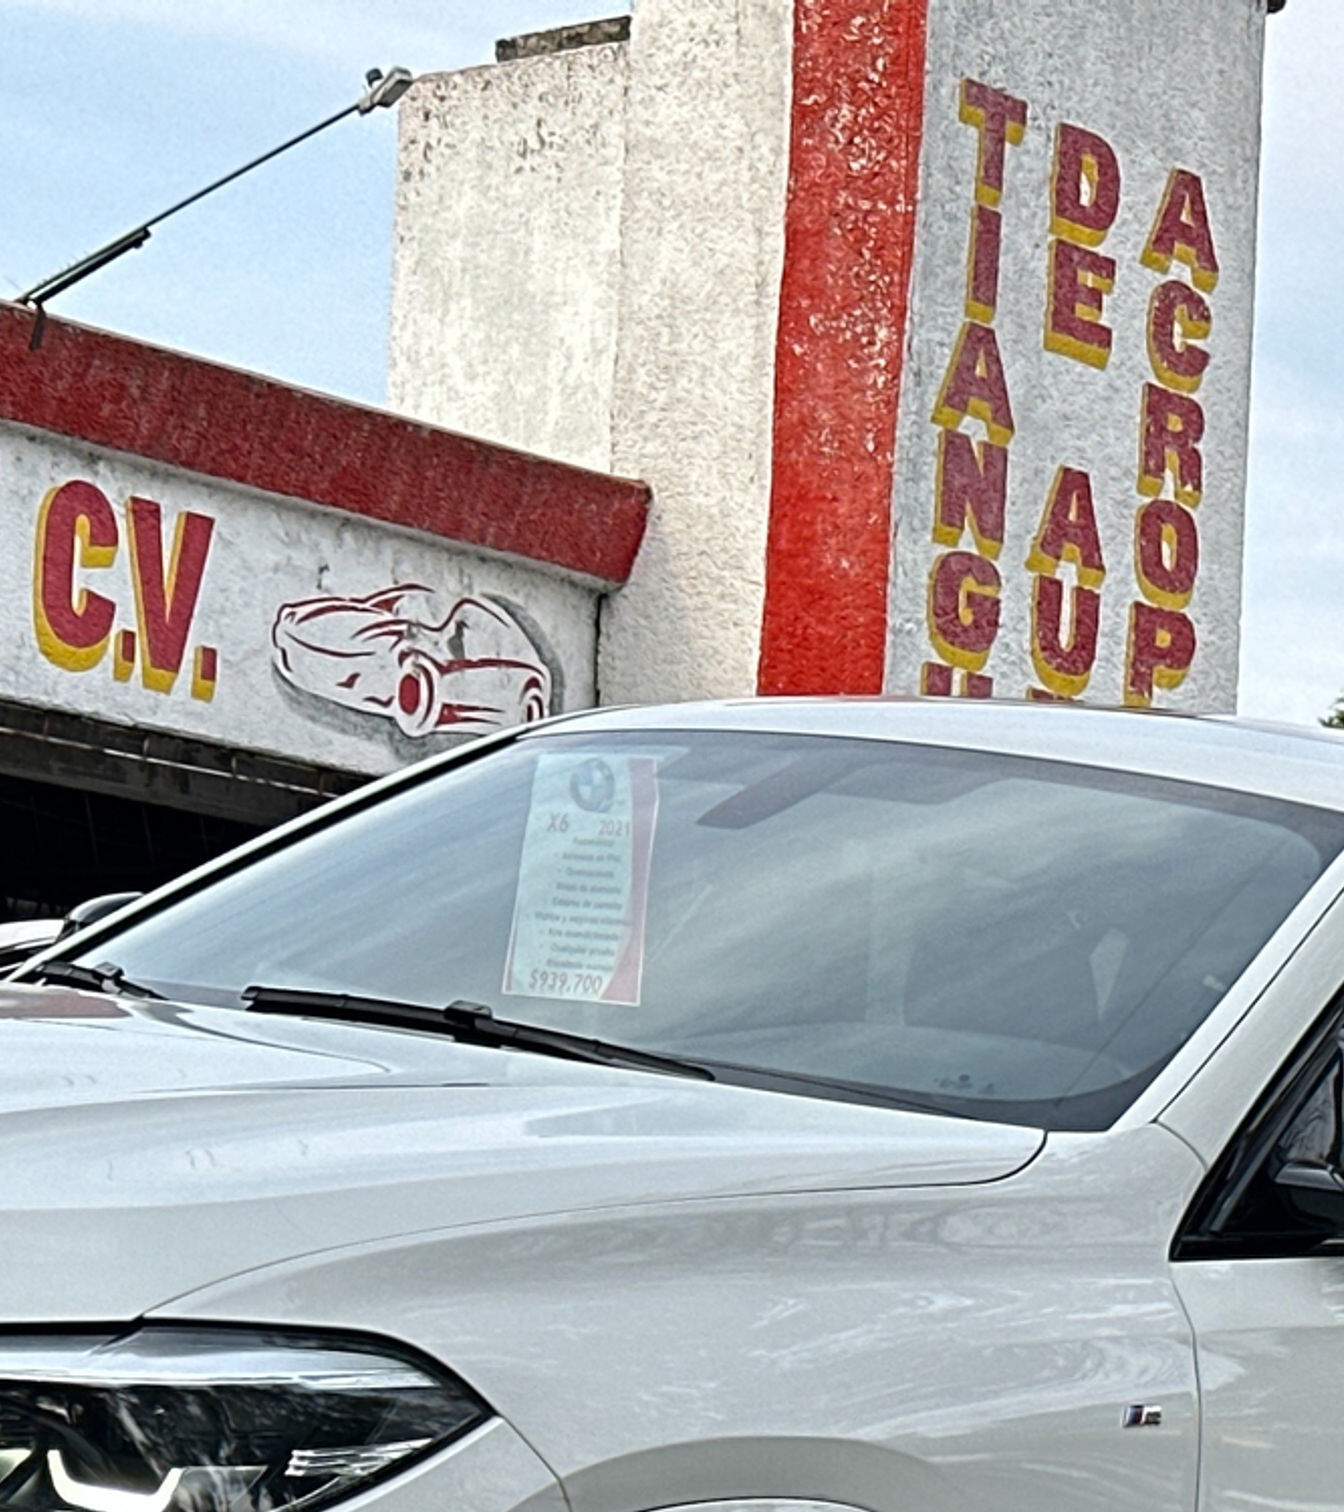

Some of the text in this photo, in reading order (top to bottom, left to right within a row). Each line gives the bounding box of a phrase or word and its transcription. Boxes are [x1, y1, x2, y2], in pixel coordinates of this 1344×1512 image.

[1043, 122, 1120, 371] DE
[33, 480, 218, 702] C.V.
[1026, 465, 1105, 705] AU
[546, 812, 631, 838] X6 2021
